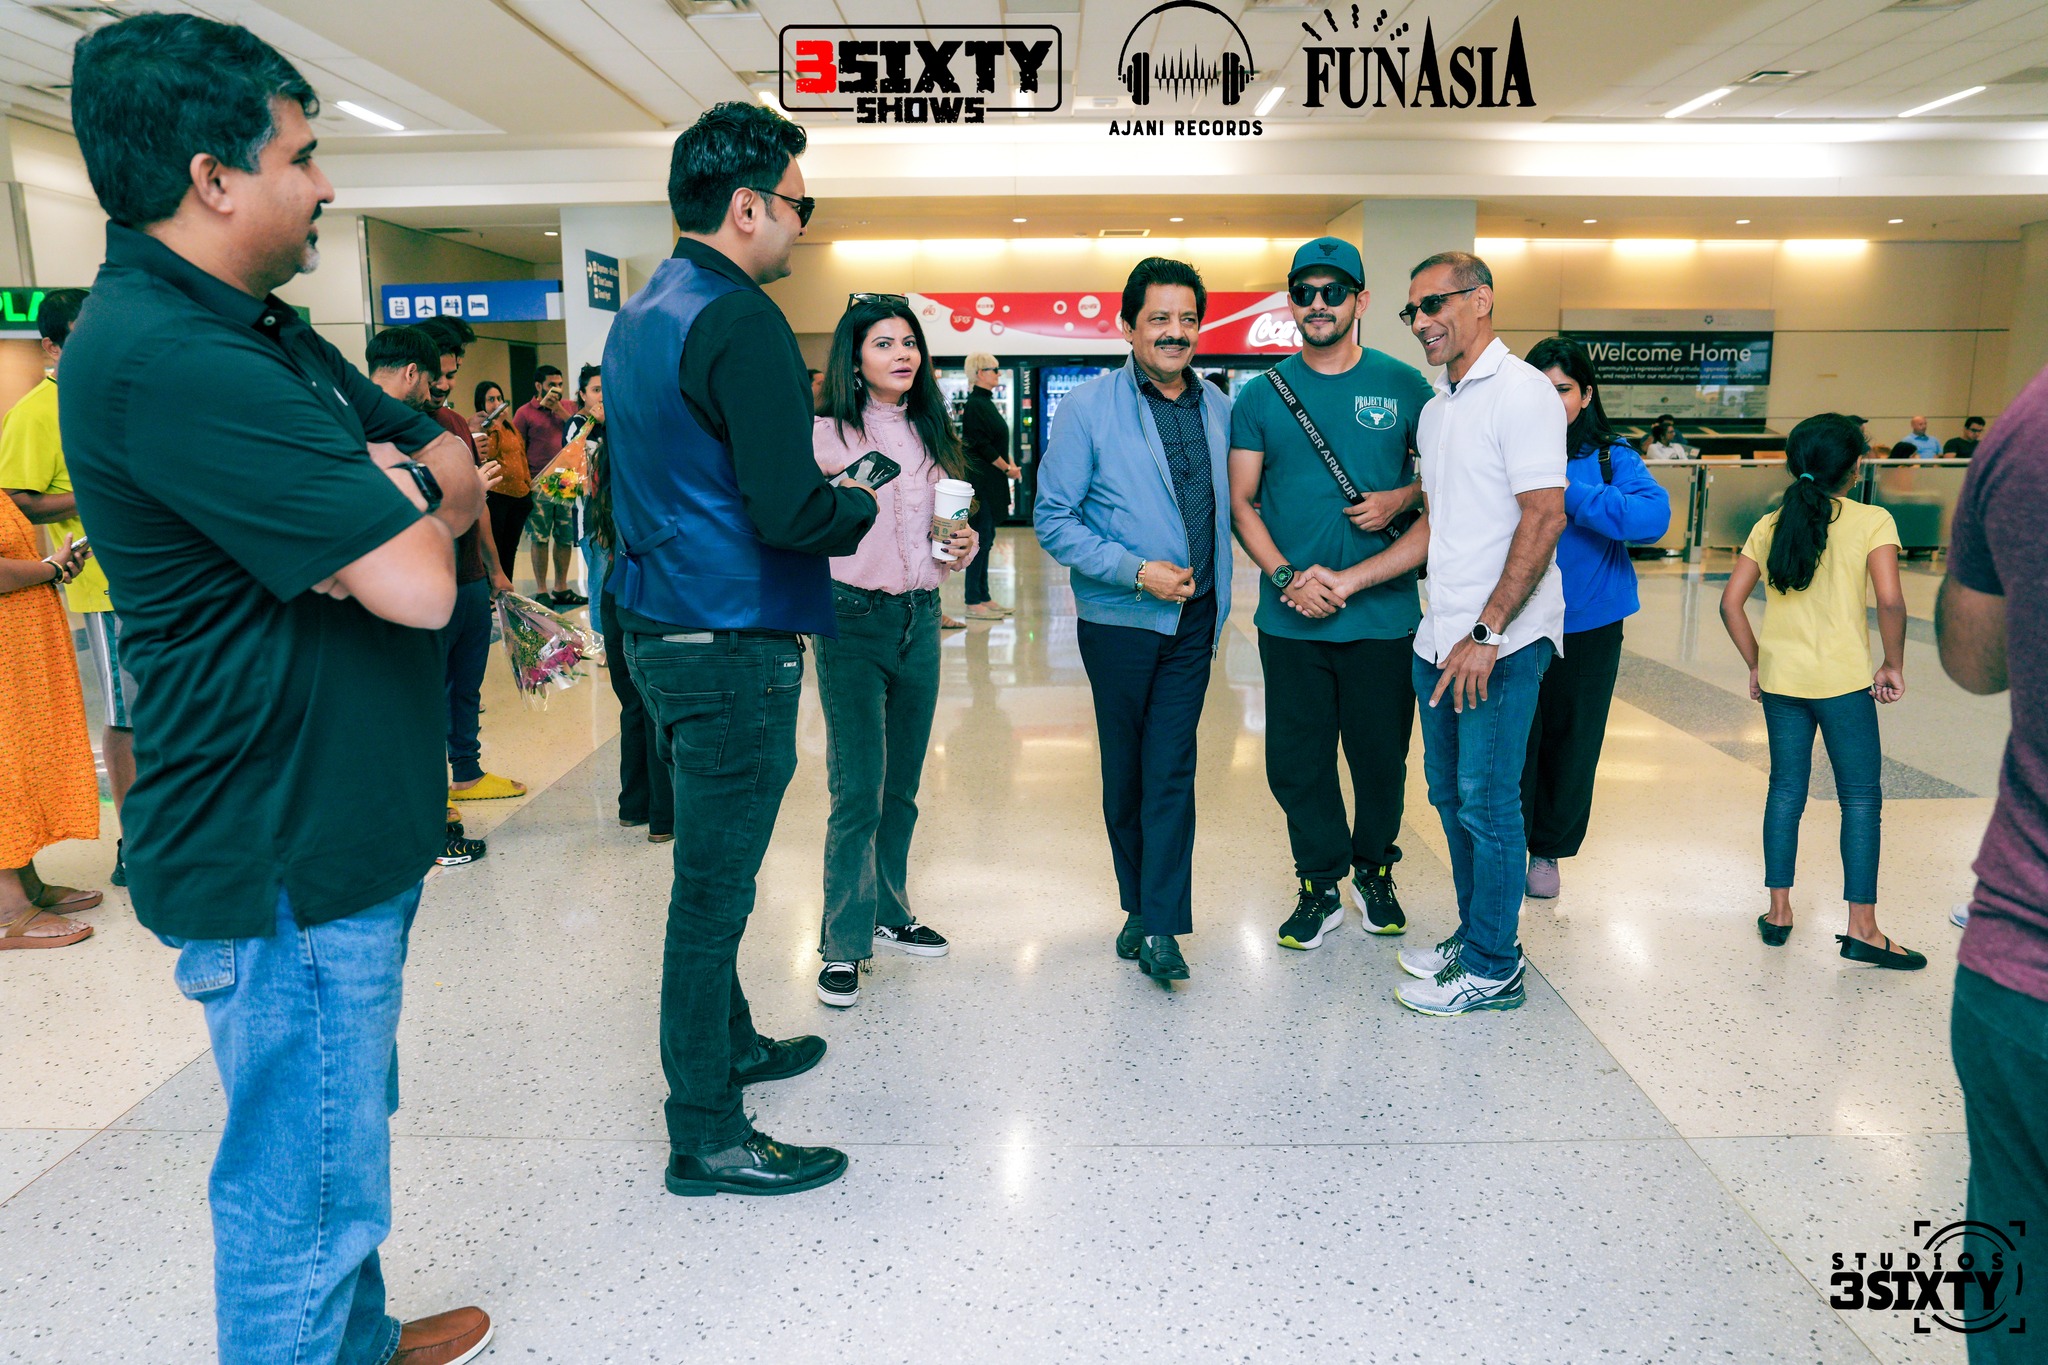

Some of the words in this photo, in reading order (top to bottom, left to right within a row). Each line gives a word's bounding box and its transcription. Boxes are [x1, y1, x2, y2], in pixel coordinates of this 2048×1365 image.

[1587, 342, 1683, 362] Welcome
[1690, 343, 1752, 362] Home
[1354, 395, 1383, 412] PROJECT
[1383, 397, 1399, 417] ROCK
[1295, 408, 1325, 450] UNDER
[1320, 449, 1358, 500] ARMOUR
